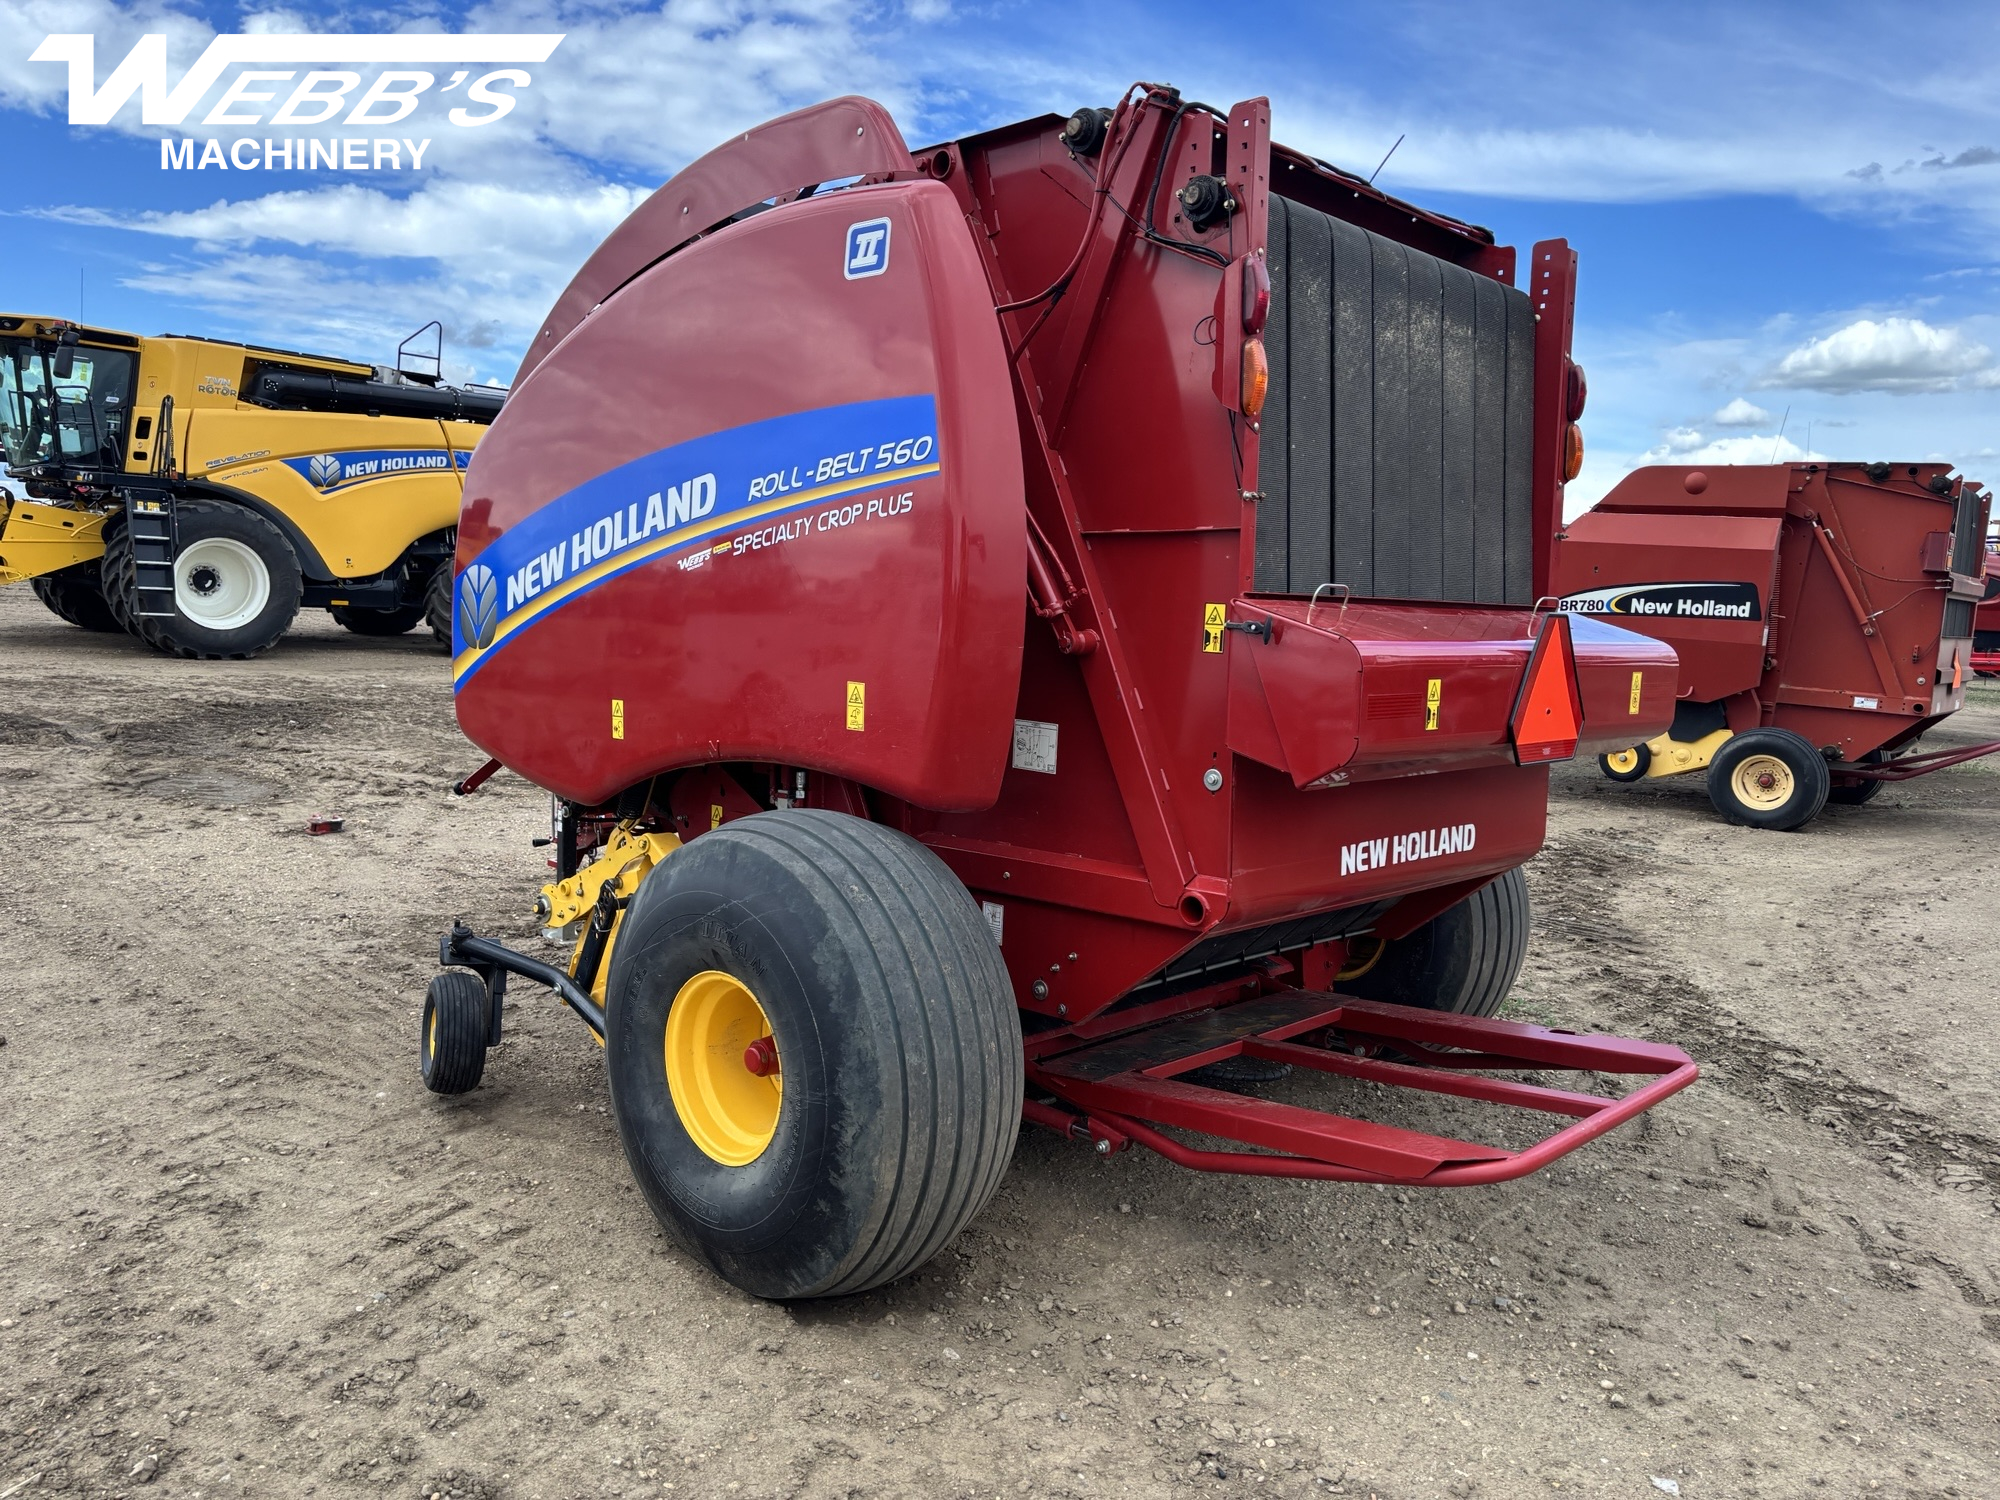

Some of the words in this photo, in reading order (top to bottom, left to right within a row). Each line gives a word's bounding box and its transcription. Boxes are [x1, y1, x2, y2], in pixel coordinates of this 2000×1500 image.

[198, 384, 237, 397] ROTOR
[205, 376, 232, 386] TWIN
[206, 449, 271, 467] REVELATION
[875, 435, 933, 470] 560
[345, 459, 378, 478] NEW
[381, 456, 447, 471] HOLLAND
[733, 515, 815, 556] SPECIALTY
[817, 503, 864, 532] CROP
[866, 492, 914, 521] PLUS
[507, 540, 567, 612] NEW
[571, 472, 717, 572] HOLLAND
[1560, 599, 1604, 612] BR780
[1630, 597, 1673, 615] New
[1677, 598, 1751, 618] Holland
[1340, 837, 1389, 876] NEW
[1392, 823, 1476, 865] HOLLAND
[701, 919, 768, 977] TITAN
